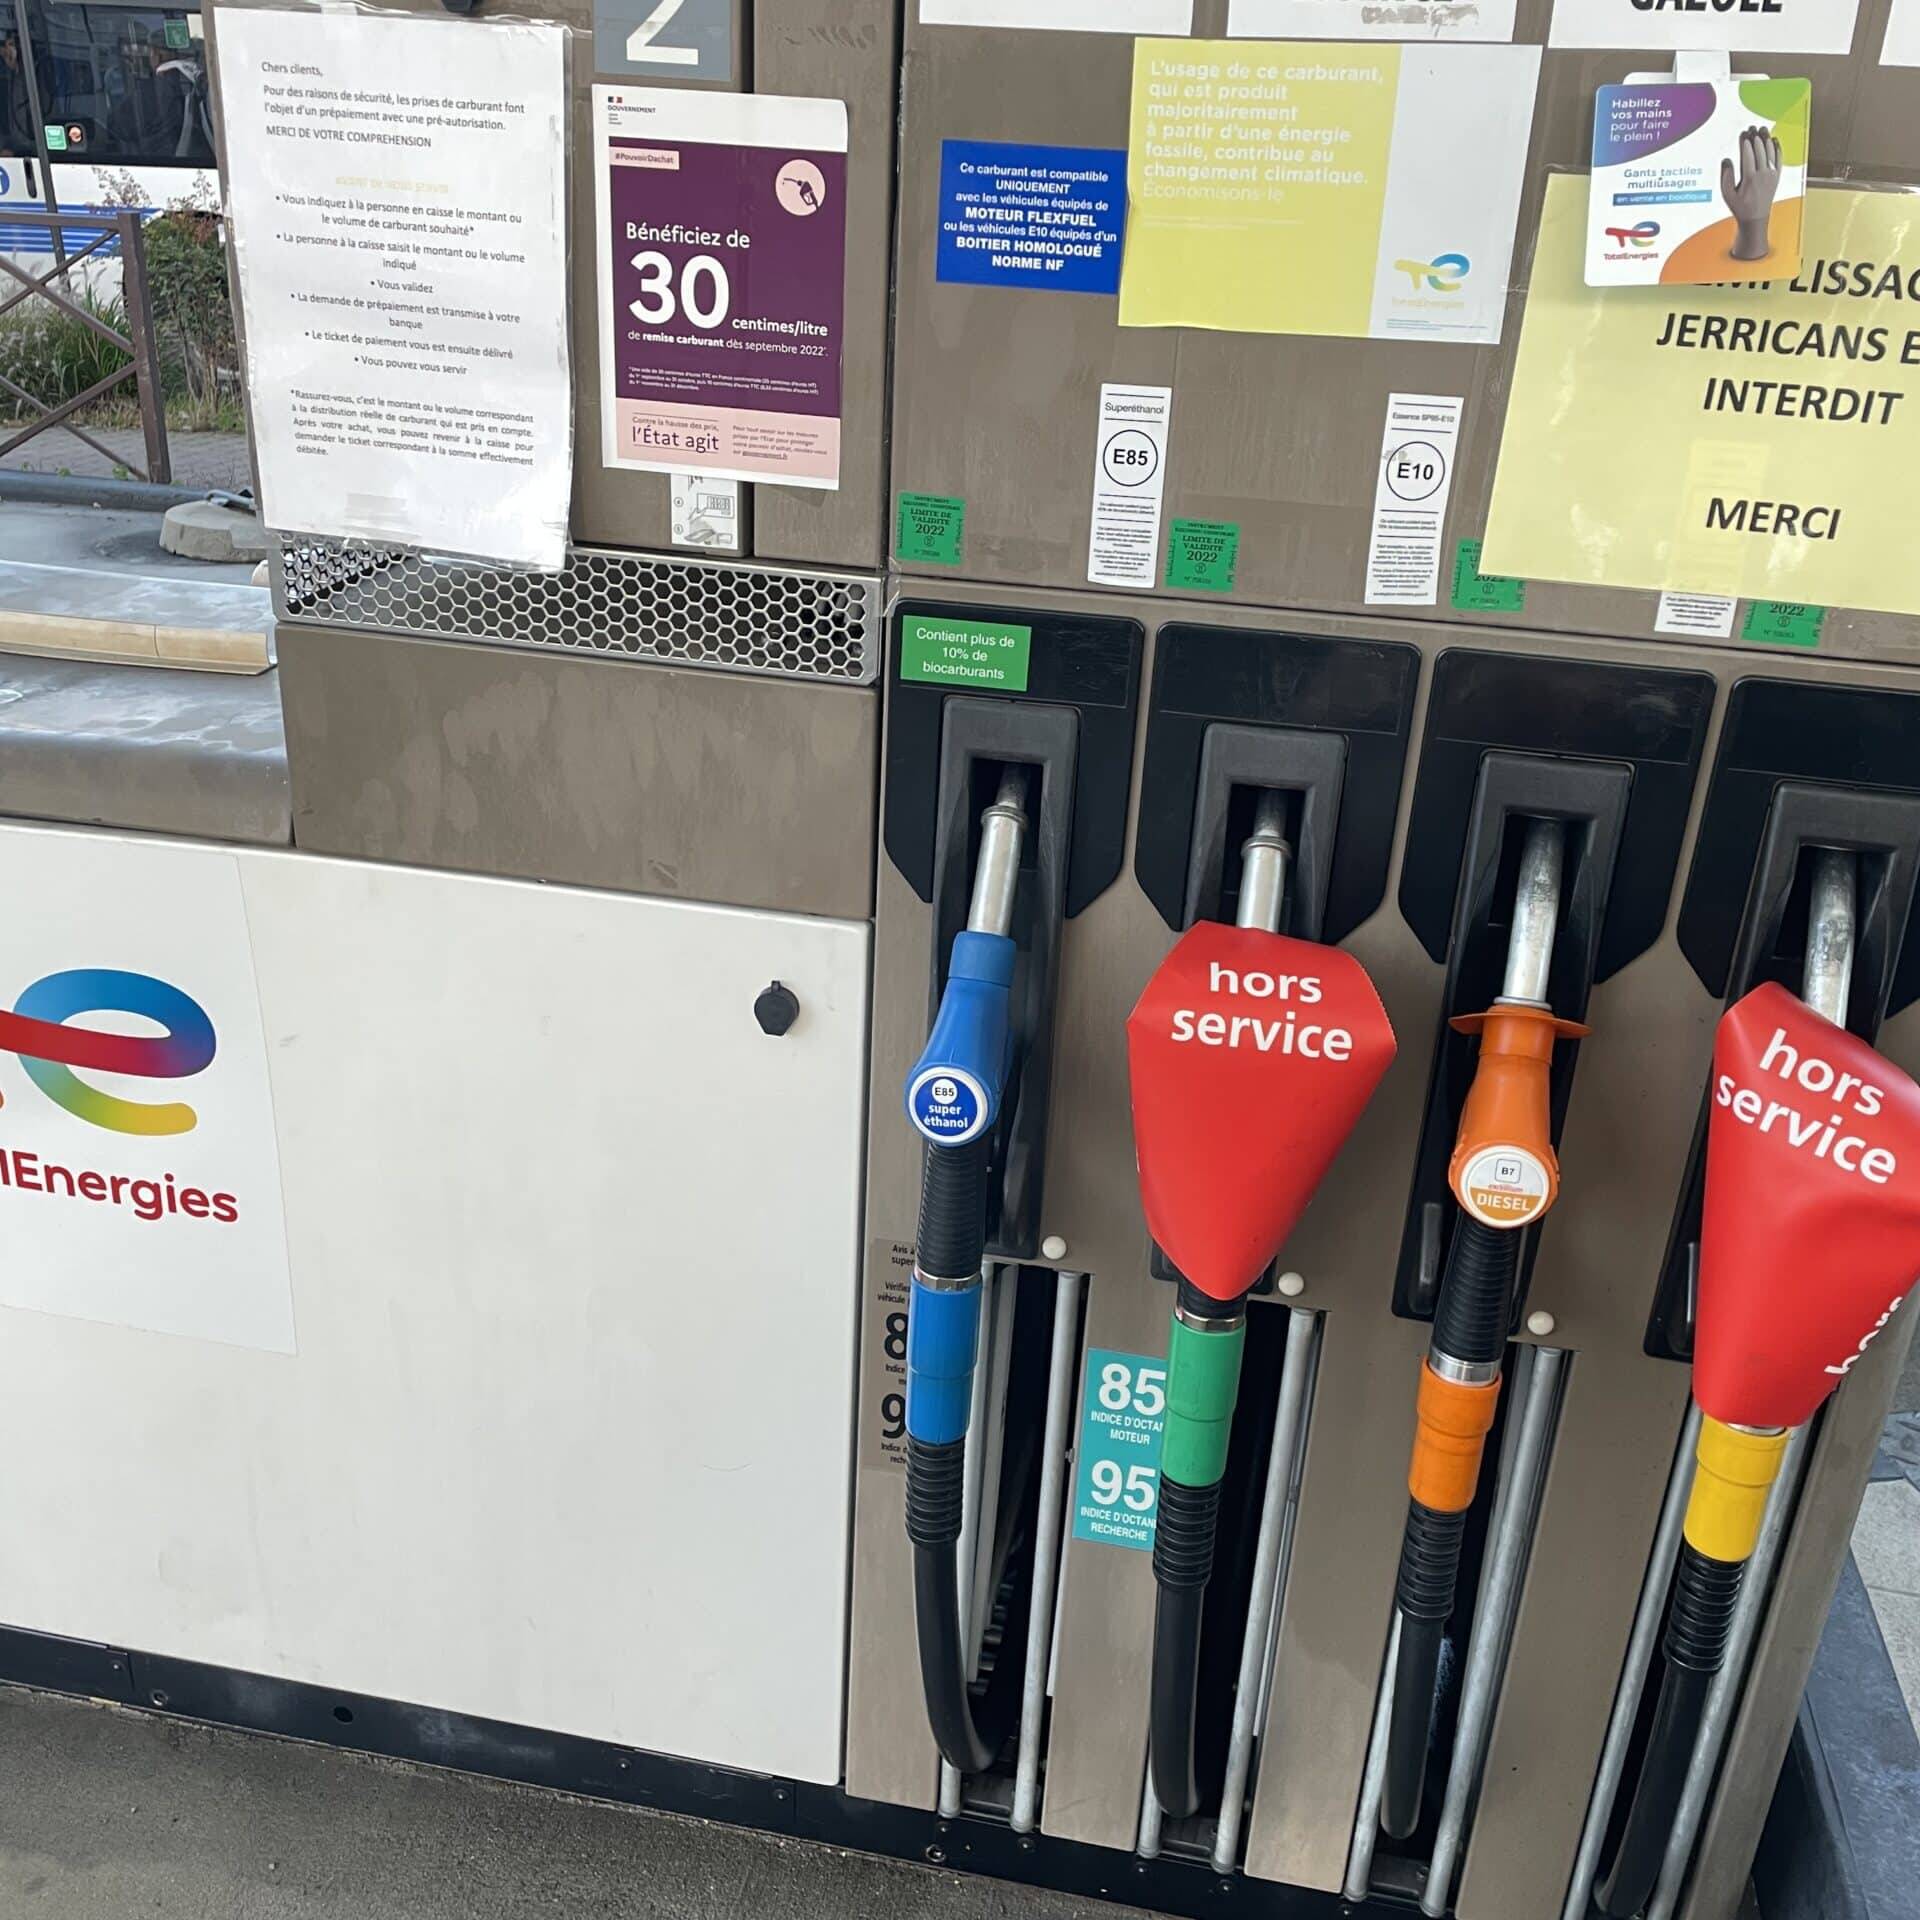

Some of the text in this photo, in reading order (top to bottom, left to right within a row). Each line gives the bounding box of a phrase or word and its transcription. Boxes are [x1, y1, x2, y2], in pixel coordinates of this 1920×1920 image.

[261, 61, 323, 77] Chers clients,
[1151, 60, 1383, 84] L'usage de ce carburant,
[263, 85, 525, 114] Pour des raisons de sécurité, les prises de carburant font
[1149, 82, 1288, 102] qui est produit
[607, 104, 656, 114] GOUVERNEMENT
[1147, 100, 1298, 121] majoritairement
[1612, 98, 1661, 109] Habillez
[264, 102, 506, 130] l'objet d'un prépaiement avec une pré-autorisation.
[1611, 109, 1673, 120] vos mains
[1146, 120, 1353, 145] à partir d'une énergie
[1611, 118, 1670, 132] pour faire
[266, 125, 431, 147] MERCI DE VOTRE COMPREHENSION
[1610, 130, 1621, 142] le
[1624, 131, 1653, 143] plein
[615, 152, 675, 166] #PouvoirDachat
[1146, 141, 1334, 163] fossile, contribue au
[960, 162, 1109, 183] Ce carburant est compatible
[1144, 160, 1368, 186] changement climatique.
[1623, 166, 1703, 178] Gants tactiles
[996, 180, 1071, 195] UNIQUEMENT
[956, 192, 1108, 211] avec les véhicules équipés de
[965, 206, 1097, 227] MOTEUR FLEXFUEL
[626, 221, 751, 249] Bénéficiez de
[944, 220, 1117, 243] ou les véhicules E10 équipés d'un
[956, 236, 1102, 258] BOITIER HOMOLOGUÉ
[1604, 251, 1659, 261] TotalEnergies
[383, 258, 416, 271] indiqué
[992, 255, 1065, 271] NORME NF
[377, 279, 433, 294] Vous validez
[628, 250, 730, 329] 30
[732, 316, 828, 338] centimes/litre
[628, 330, 641, 342] de
[643, 332, 675, 344] remise
[677, 334, 724, 348] carburant
[726, 338, 743, 351] dès
[745, 341, 797, 355] septembre
[1656, 313, 1889, 362] JERRICANS
[361, 355, 467, 375] Vous pouvez vous servir
[1104, 402, 1165, 414] Superéthanol
[1703, 378, 1904, 425] INTERDIT
[632, 425, 680, 447] l'État
[685, 432, 720, 453] agit
[1113, 448, 1149, 466] E85
[1397, 462, 1434, 481] E10
[910, 508, 940, 518] LIMITE
[1705, 498, 1841, 540] MERCI
[915, 523, 945, 536] 2022
[1182, 535, 1211, 544] LIMITE
[1186, 550, 1218, 563] 2022
[1769, 603, 1805, 617] 2022
[916, 627, 1015, 648] Contient plus de
[942, 647, 988, 662] 10% de
[922, 661, 1005, 680] biocarburants
[1209, 961, 1322, 1004] hors
[1170, 1009, 1353, 1061] service
[1758, 1027, 1885, 1117] hors
[934, 1087, 955, 1097] E85
[928, 1104, 962, 1117] super
[923, 1115, 968, 1128] éthanol
[1715, 1074, 1897, 1185] service
[1501, 1167, 1515, 1176] B7
[1476, 1193, 1531, 1212] DIESEL
[891, 1255, 915, 1267] super
[885, 1281, 911, 1293] Vérifie
[1098, 1363, 1167, 1416] 85
[1091, 1410, 1122, 1427] INDICE
[1110, 1428, 1151, 1445] MOTEUR
[1091, 1459, 1156, 1512] 95
[1080, 1506, 1112, 1521] INDICE
[1091, 1521, 1148, 1541] RECHERCHE
